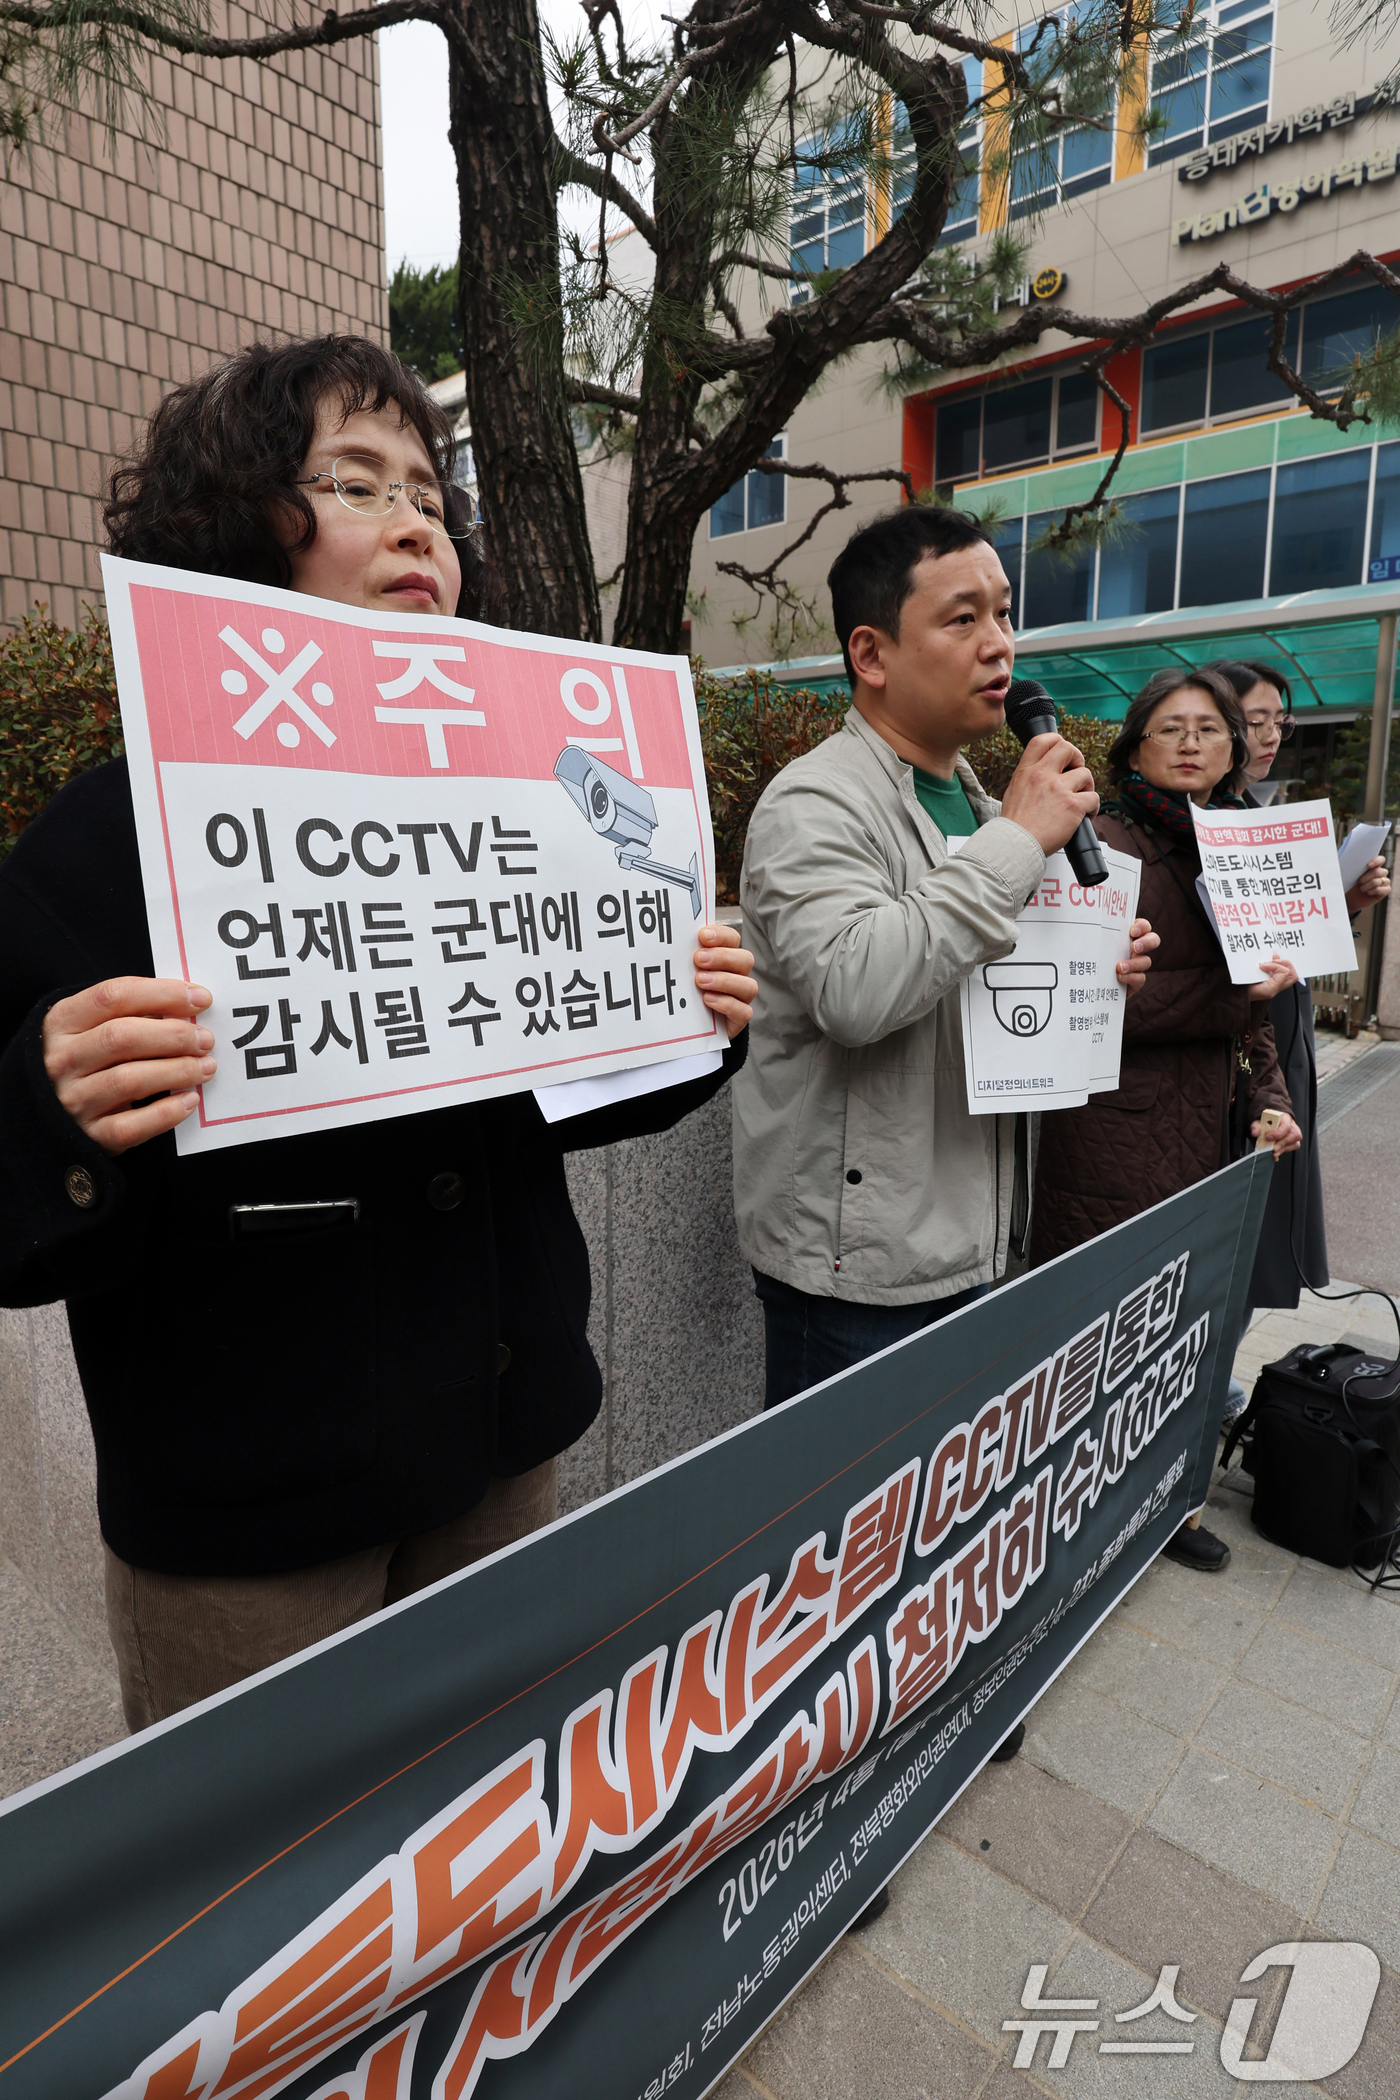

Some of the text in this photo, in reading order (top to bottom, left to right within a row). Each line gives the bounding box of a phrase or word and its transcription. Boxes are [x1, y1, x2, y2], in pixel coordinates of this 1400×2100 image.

[1370, 559, 1400, 580] 임
[205, 808, 539, 883] 이 CCTV는
[1213, 829, 1235, 843] 탄핵
[1251, 826, 1287, 842] 감시한
[1291, 820, 1322, 837] 군대!
[1027, 878, 1062, 907] 군
[1262, 896, 1329, 925] 시민감시
[218, 888, 672, 981] 언제든 군대에 의해
[1227, 932, 1260, 953] 철저히
[232, 959, 687, 1079] 감시될 수 있습니다.
[978, 1077, 1054, 1091] 디지털정의네트워크
[915, 1311, 1110, 1558] CCTV를
[1103, 1250, 1190, 1394] 통한
[881, 1465, 1053, 1738] 철저히
[1053, 1311, 1209, 1541] 수사하라!
[700, 1851, 851, 2052] 전남노동권익센터,
[850, 1702, 972, 1867] 전북평화와인권연대,
[718, 1791, 830, 1943] 2026년
[832, 1746, 888, 1810] 4월
